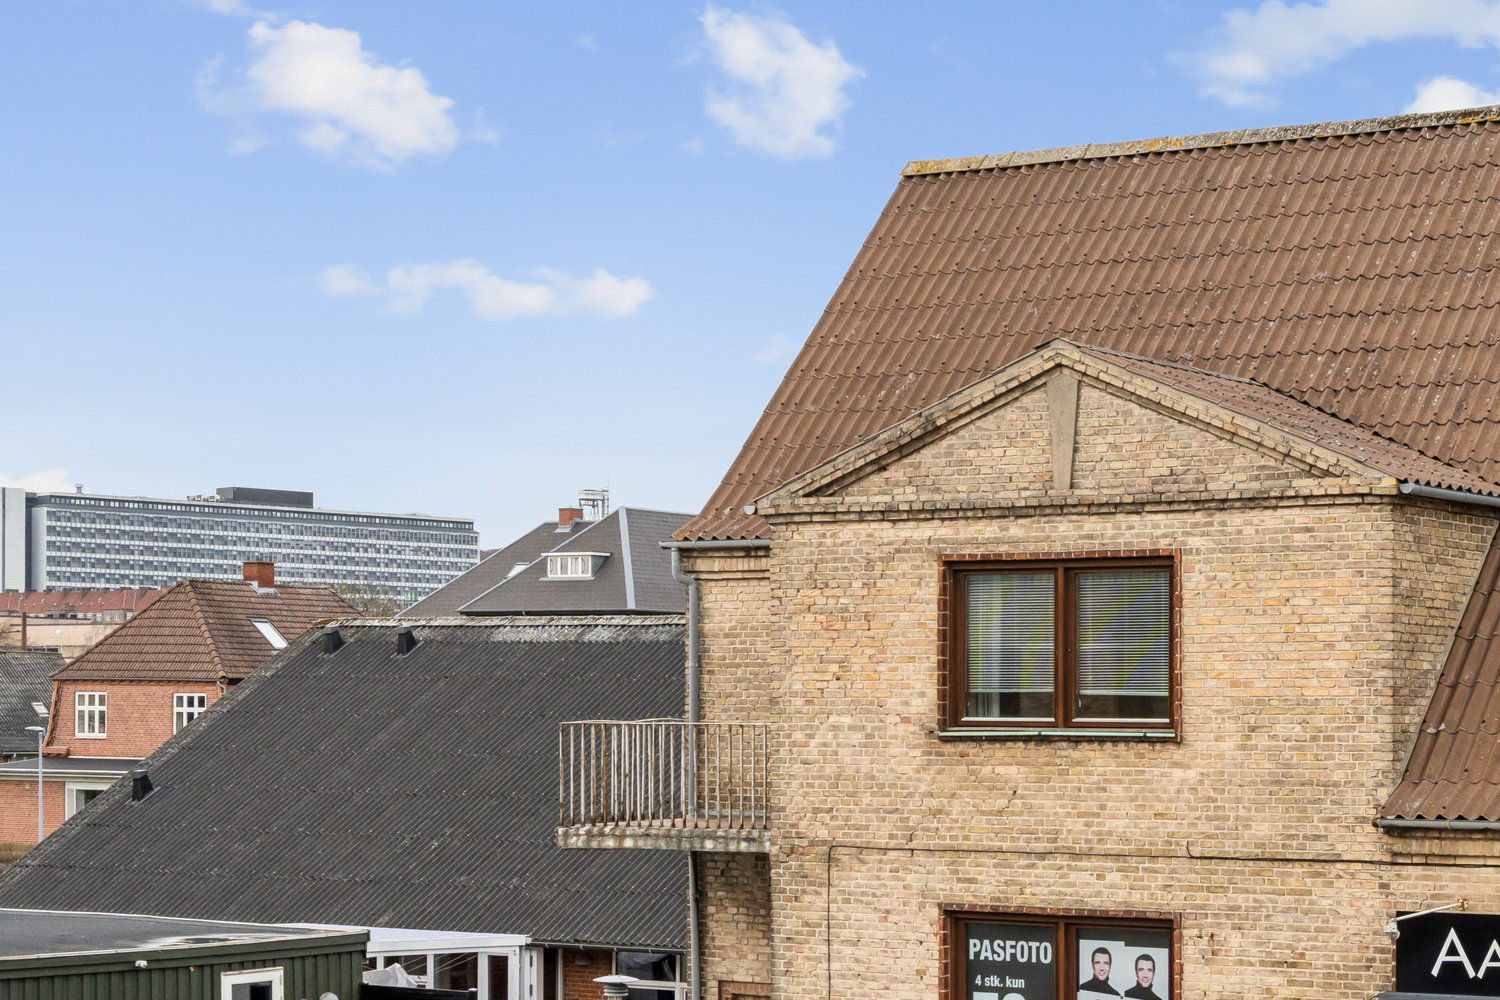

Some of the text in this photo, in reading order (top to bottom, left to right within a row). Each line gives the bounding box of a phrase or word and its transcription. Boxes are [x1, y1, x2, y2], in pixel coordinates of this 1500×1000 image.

[969, 938, 1052, 964] PASFOTO
[975, 974, 1025, 988] 4 stk. kun
